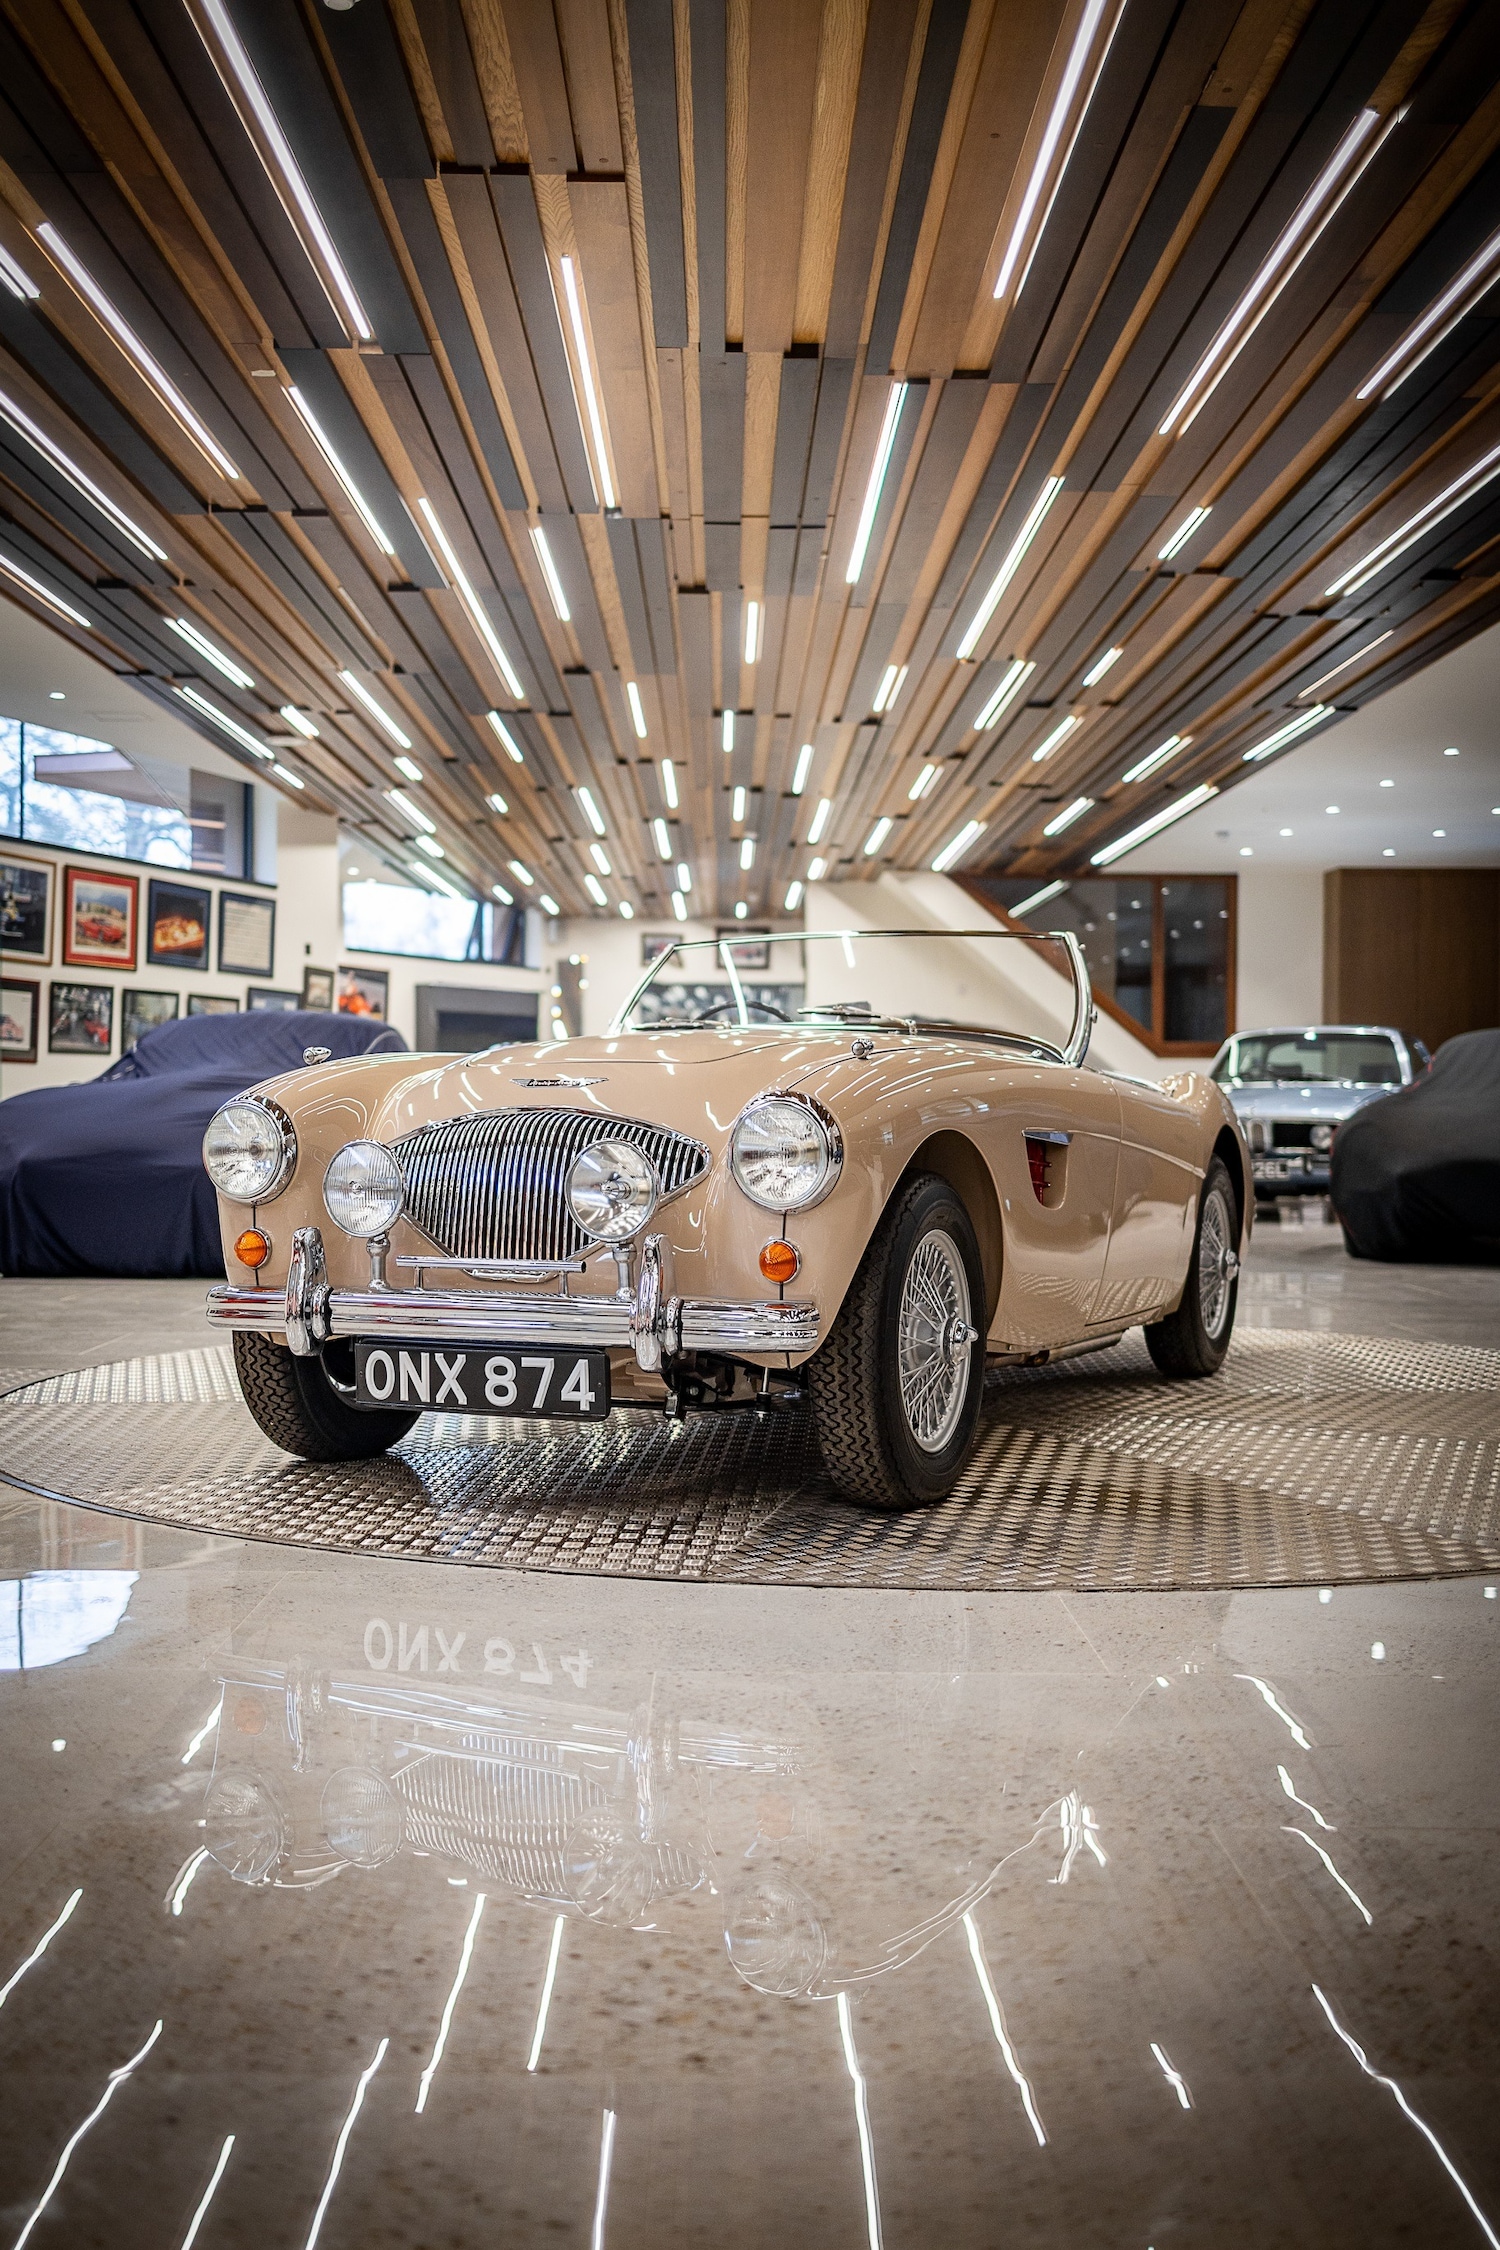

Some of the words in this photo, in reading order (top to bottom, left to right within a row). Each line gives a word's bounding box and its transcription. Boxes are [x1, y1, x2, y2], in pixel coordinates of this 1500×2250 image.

[1251, 1161, 1289, 1179] 26L
[365, 1350, 467, 1405] ONX
[484, 1356, 596, 1411] 874
